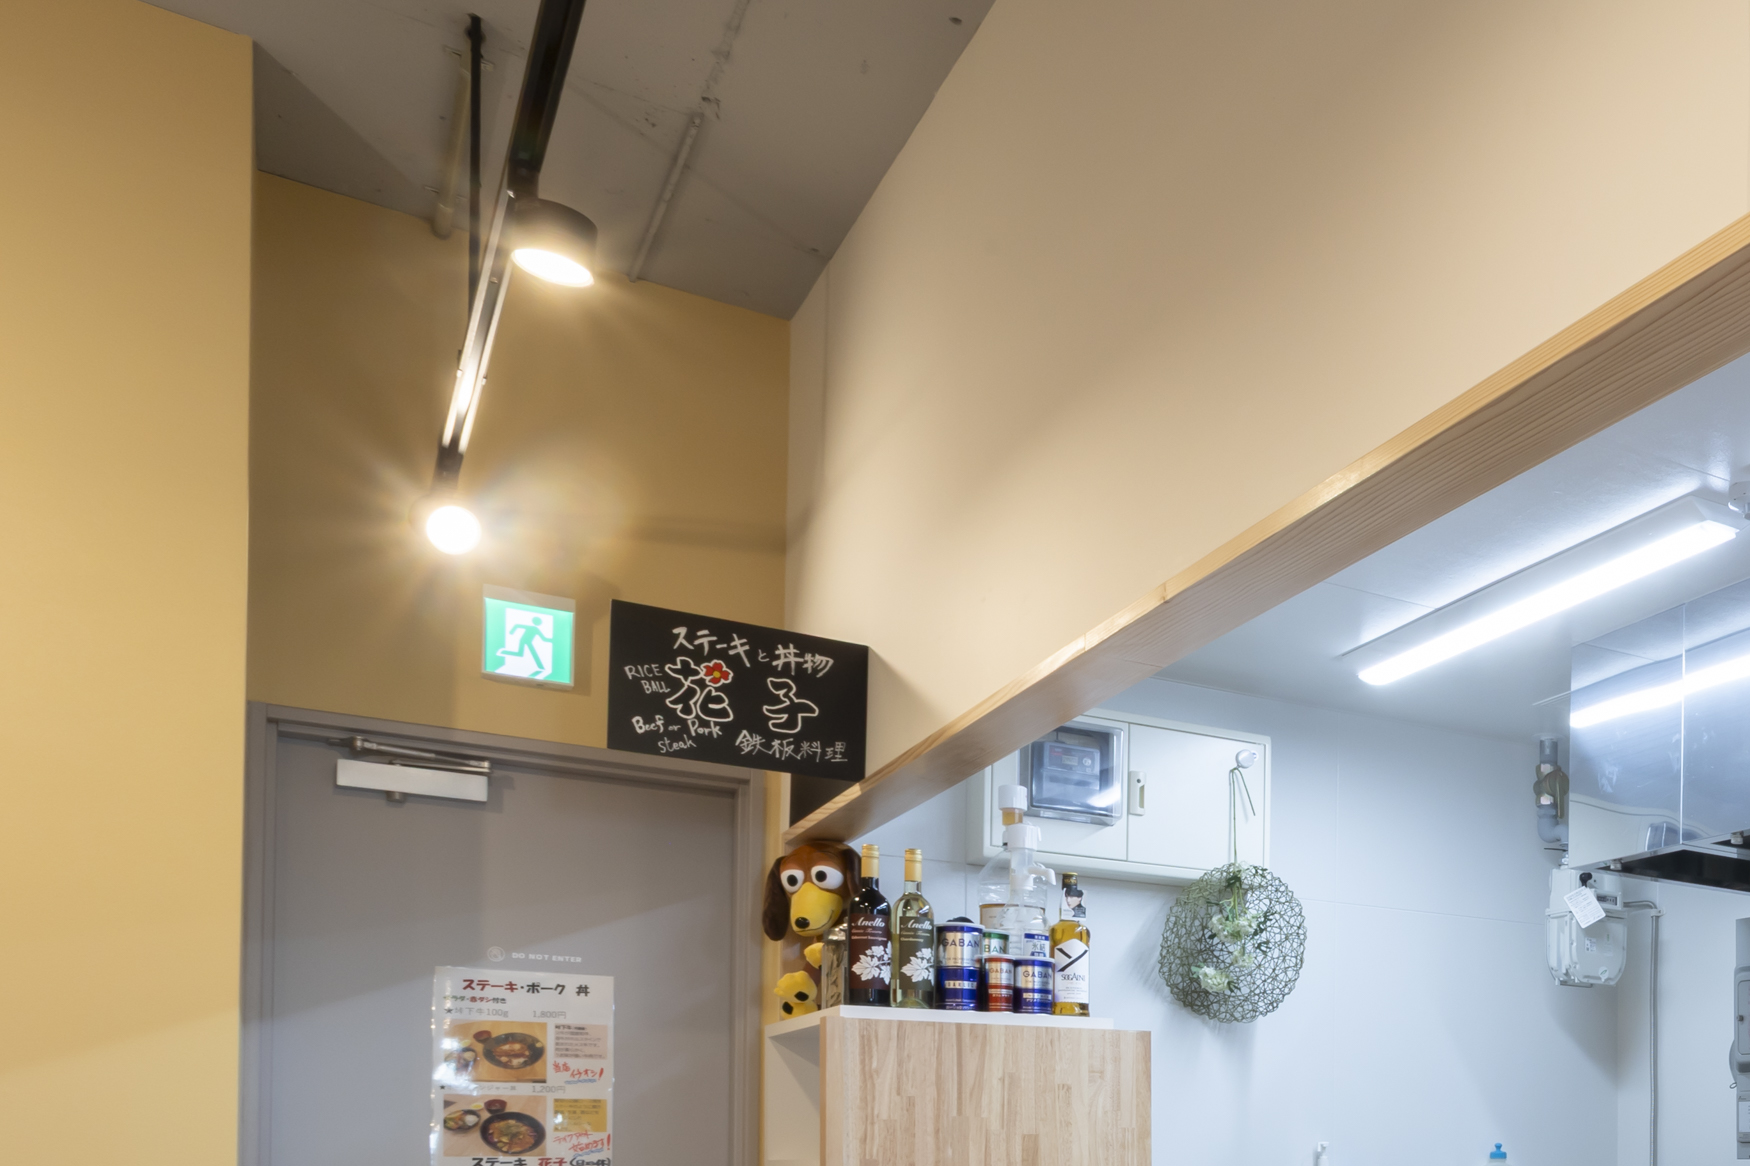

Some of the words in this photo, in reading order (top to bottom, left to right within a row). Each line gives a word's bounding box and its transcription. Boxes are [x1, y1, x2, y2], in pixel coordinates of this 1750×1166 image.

[672, 625, 834, 679] ステーキと丼物
[624, 663, 663, 680] RICE
[641, 679, 671, 695] BALL
[631, 715, 665, 734] Beef
[687, 718, 723, 738] Pork
[658, 737, 697, 754] steak
[735, 729, 848, 763] 鉄板料理
[851, 916, 886, 928] Anello
[900, 918, 933, 930] Anello
[942, 938, 980, 948] GABAN
[984, 944, 1007, 953] BAN
[511, 952, 526, 960] DO
[528, 953, 549, 961] NOT
[552, 955, 582, 963] ENTER
[989, 966, 1013, 974] GABAN
[1022, 970, 1052, 979] GABAN
[576, 984, 591, 997] 丼
[532, 1010, 567, 1020] 1,800円
[532, 1085, 566, 1094] 1,200円
